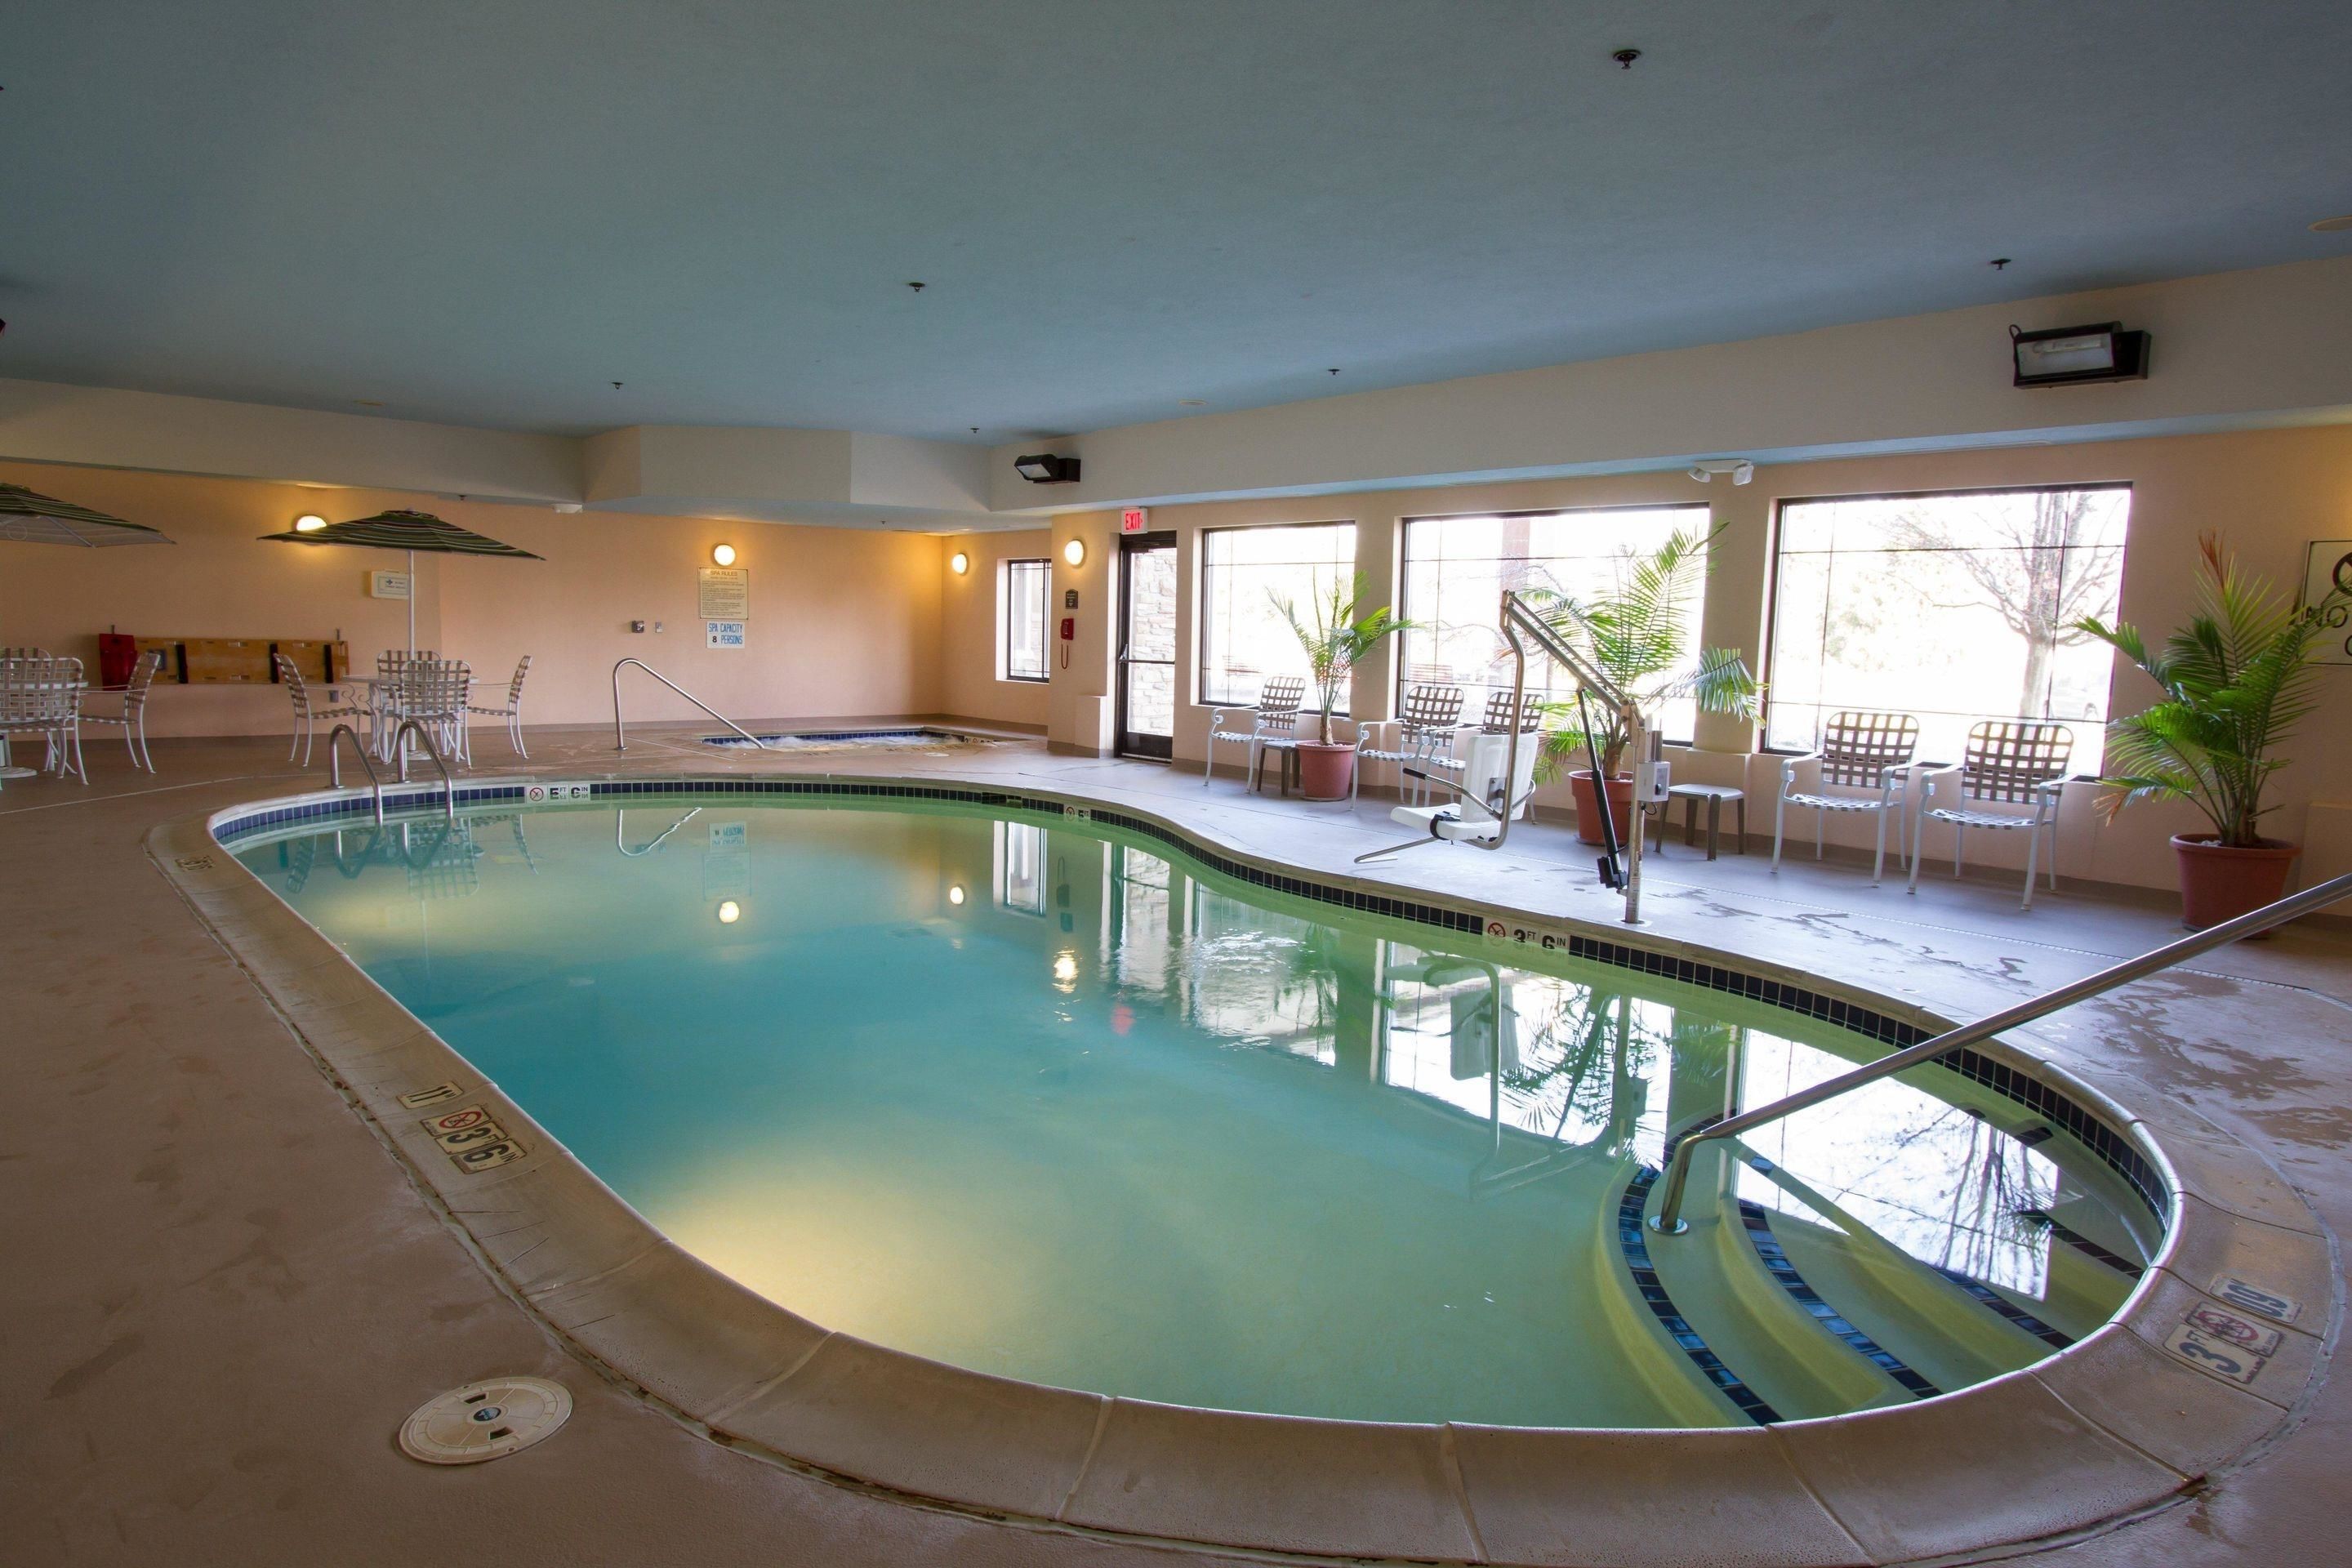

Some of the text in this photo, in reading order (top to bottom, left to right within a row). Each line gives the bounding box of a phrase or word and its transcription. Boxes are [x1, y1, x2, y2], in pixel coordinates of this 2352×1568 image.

[1125, 512, 1141, 530] EXIT
[709, 623, 742, 633] SPA CAPACITY
[721, 635, 742, 644] PERSONS
[1526, 931, 1536, 940] FT
[1557, 937, 1566, 947] IN
[447, 1127, 492, 1144] 3
[481, 1134, 500, 1144] FT
[463, 1143, 510, 1163] 6
[500, 1152, 519, 1163] IN
[2179, 1330, 2241, 1374] 3 FT
